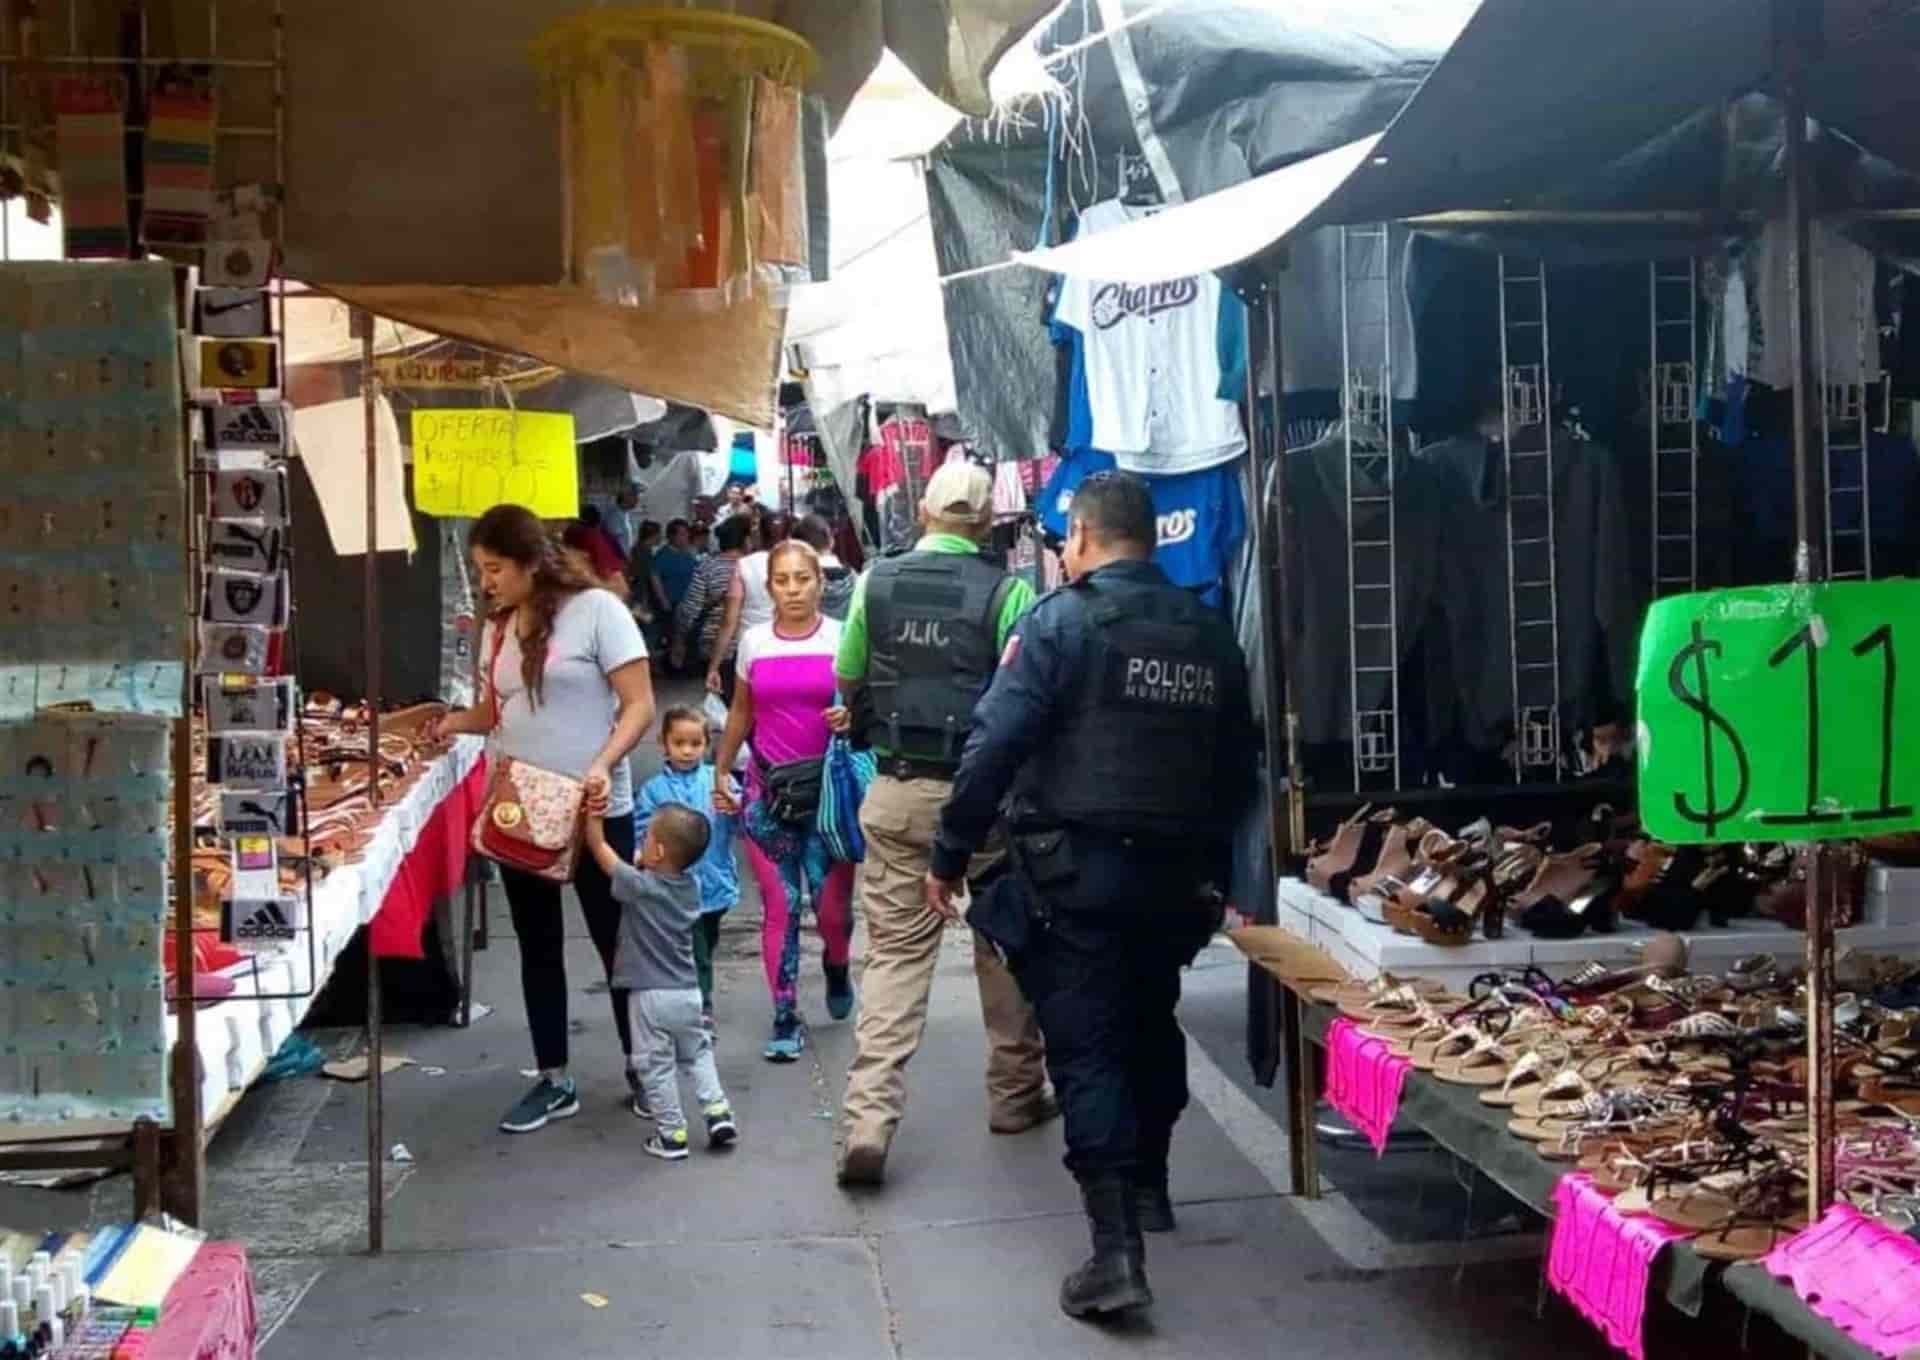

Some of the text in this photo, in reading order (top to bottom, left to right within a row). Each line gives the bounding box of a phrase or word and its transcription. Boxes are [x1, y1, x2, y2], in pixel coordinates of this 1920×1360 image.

[1092, 274, 1199, 330] Charros
[1126, 657, 1217, 691] POLICIA
[236, 926, 296, 941] adidas
